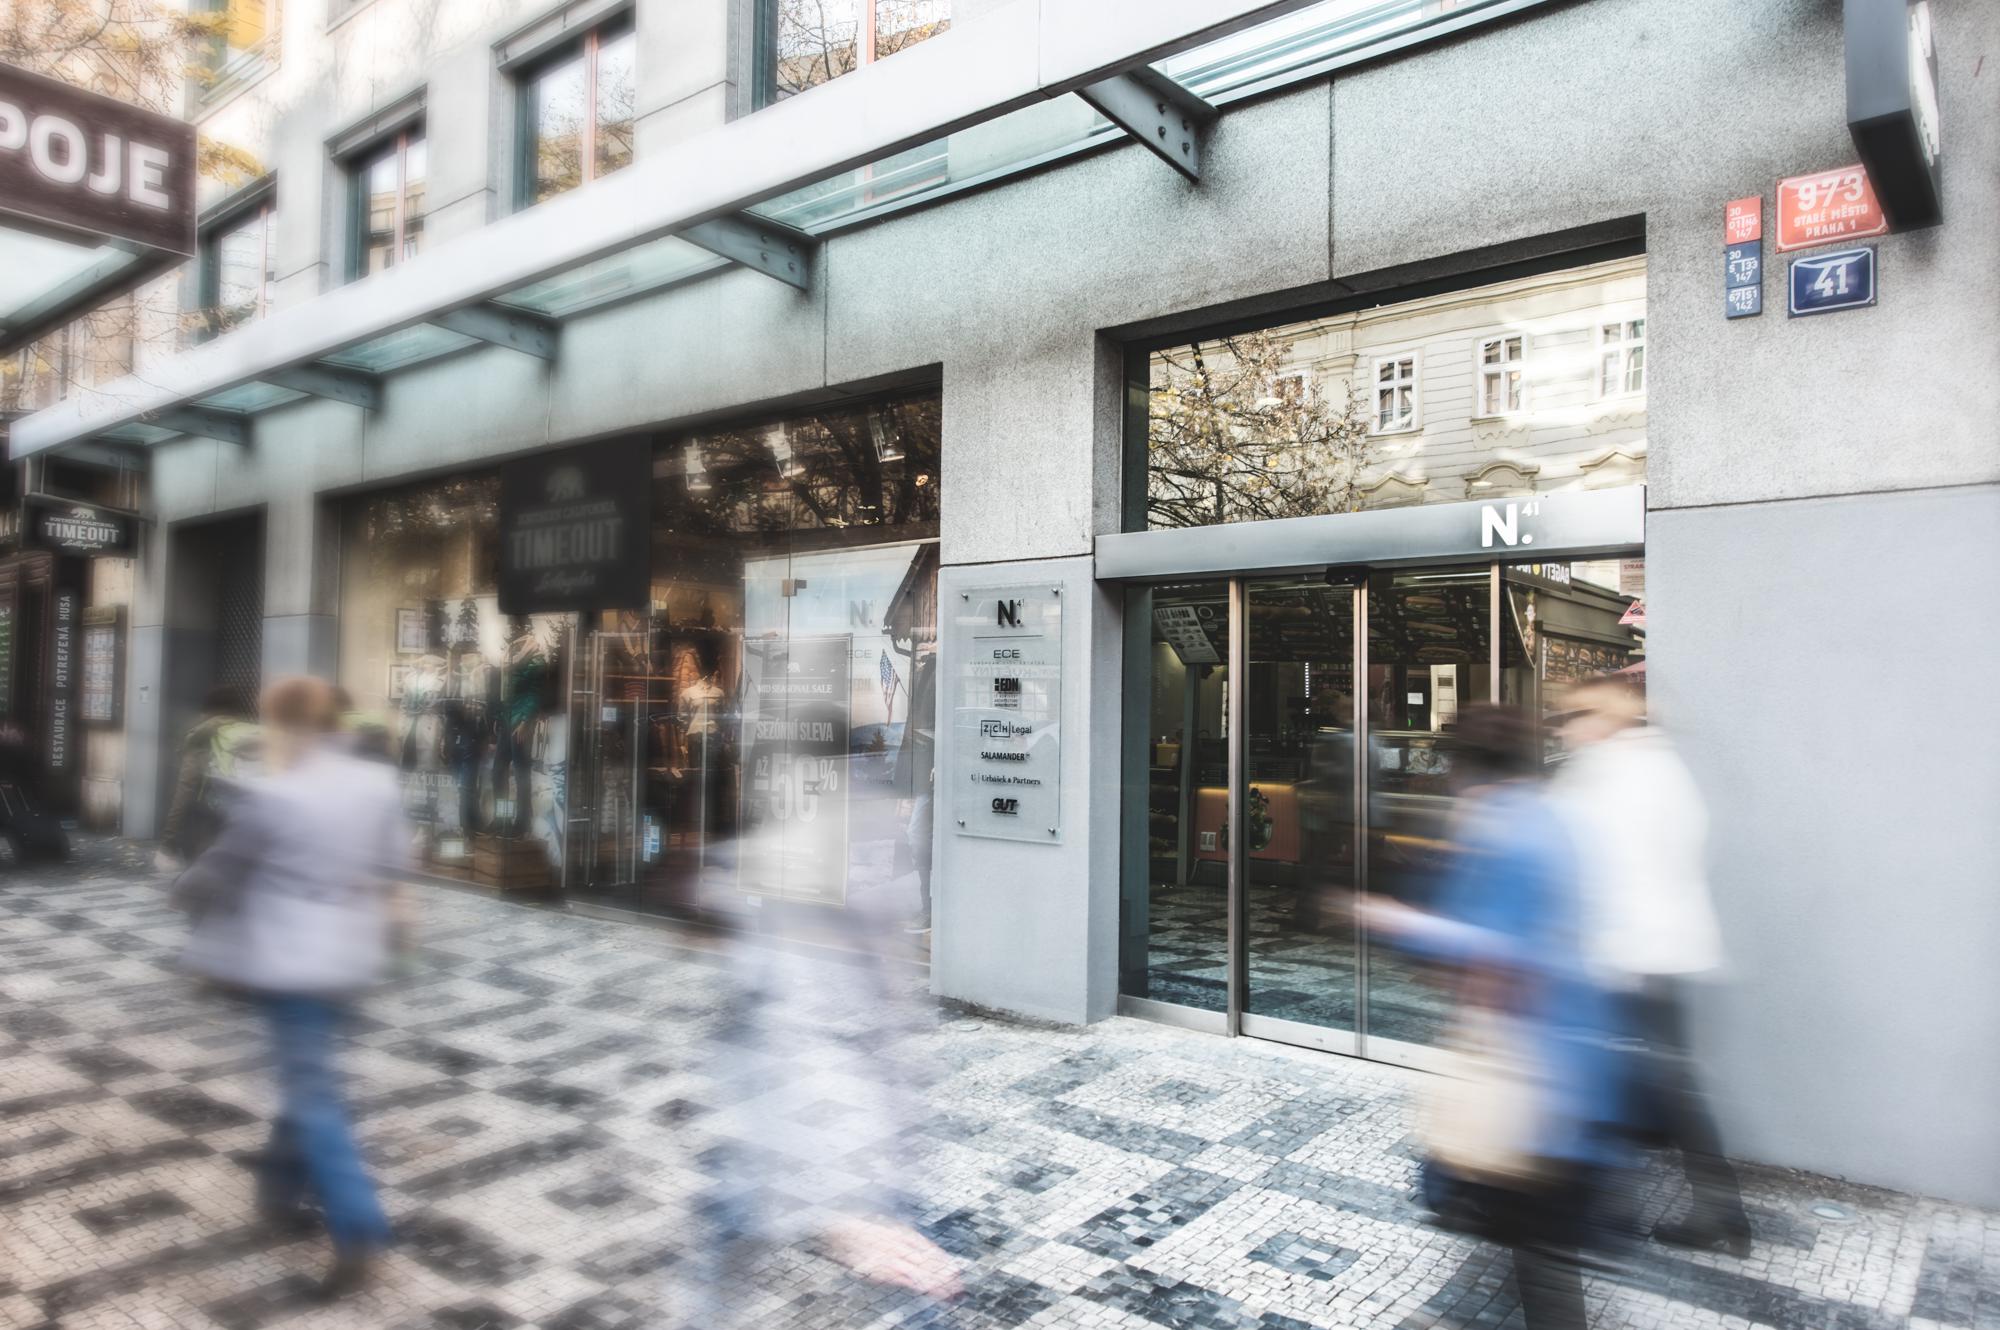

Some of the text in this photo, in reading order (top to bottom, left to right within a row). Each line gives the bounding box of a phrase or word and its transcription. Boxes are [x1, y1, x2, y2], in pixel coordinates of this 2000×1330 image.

[1798, 173, 1864, 211] 973
[1794, 204, 1868, 228] STARÉ MĚSTO
[1805, 219, 1856, 238] PRAHA 1
[1729, 250, 1741, 260] 30
[1814, 263, 1849, 296] 41
[44, 522, 119, 543] TIMEOUT
[510, 517, 623, 570] TIMEOUT
[993, 649, 1020, 659] ECE
[52, 698, 66, 767] RESTAURACE
[59, 596, 71, 620] HUSA
[811, 684, 833, 694] SALE
[757, 718, 834, 742] SEZÓNNÍ SLEVA
[1011, 725, 1032, 735] Legal
[755, 755, 769, 777] AŽ
[981, 751, 1025, 761] SALAMANDER
[1013, 776, 1041, 785] Partners
[992, 798, 1018, 811] GUT
